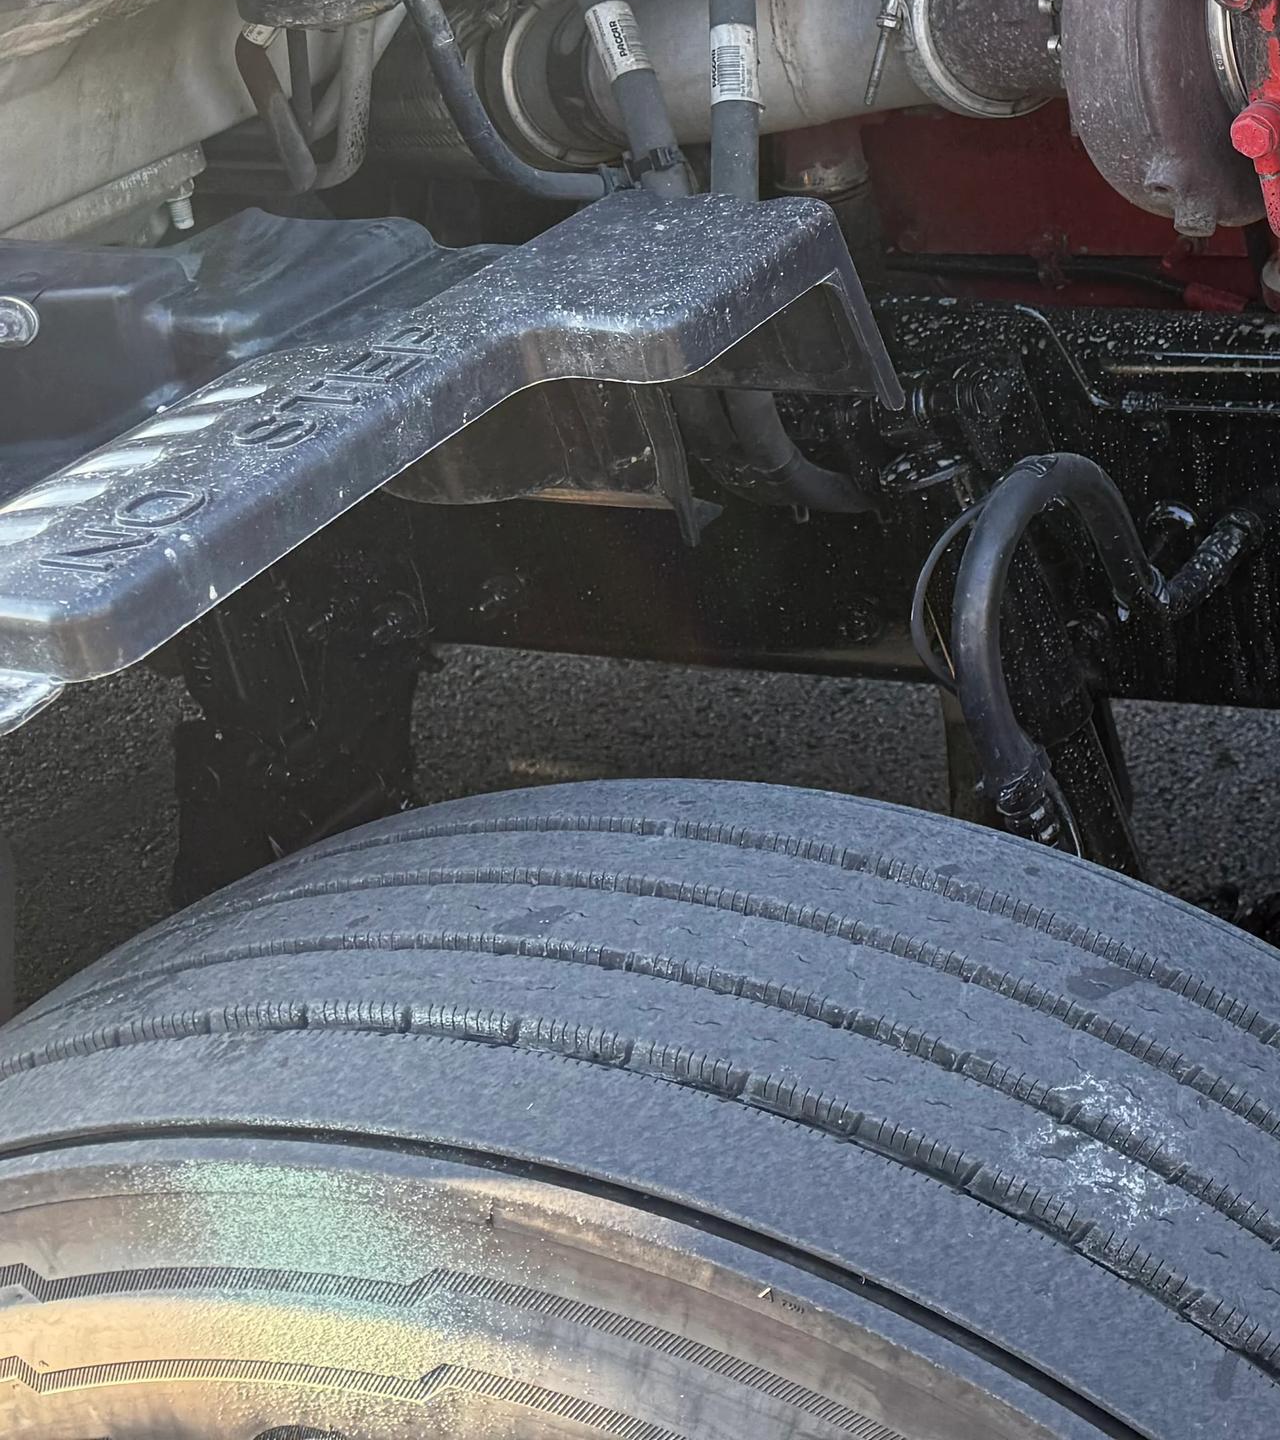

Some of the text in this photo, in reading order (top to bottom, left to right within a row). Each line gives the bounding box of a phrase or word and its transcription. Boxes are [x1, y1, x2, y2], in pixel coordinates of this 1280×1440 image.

[608, 21, 628, 57] PACCAR
[38, 326, 437, 574] NO STEP
